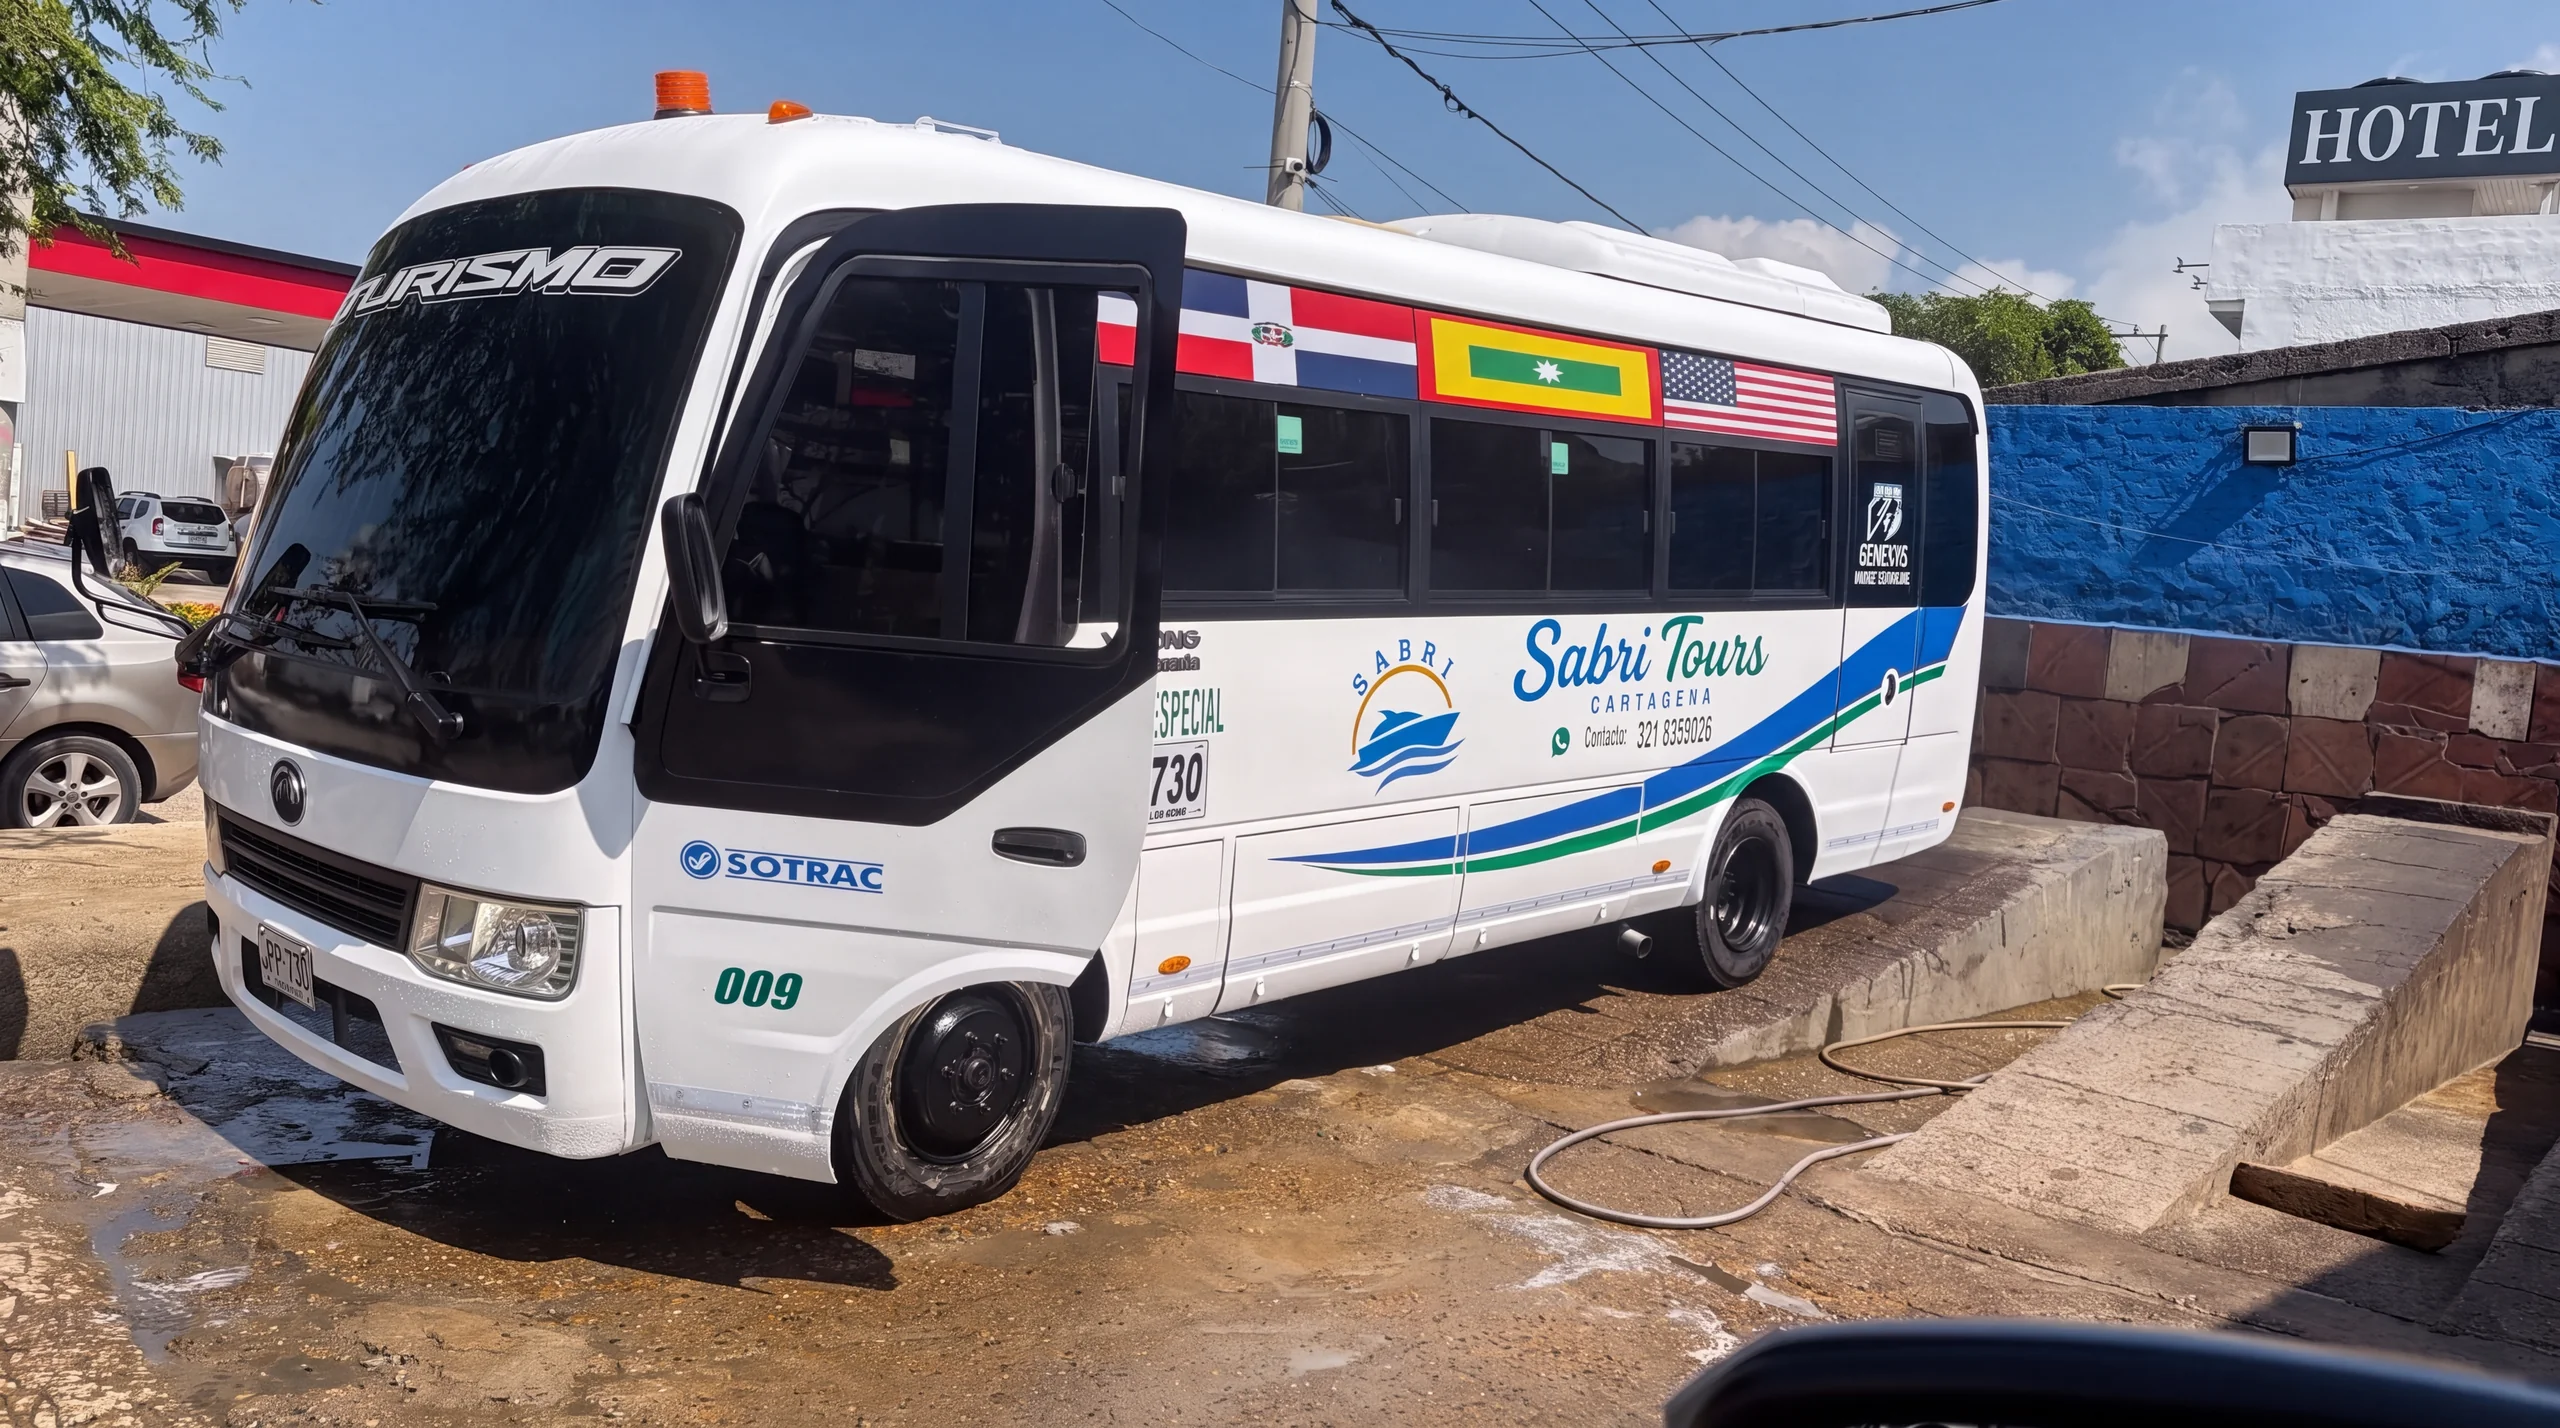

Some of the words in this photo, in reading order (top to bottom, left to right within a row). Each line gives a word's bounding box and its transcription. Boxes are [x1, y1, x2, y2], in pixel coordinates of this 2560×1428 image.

[2299, 96, 2556, 164] HOTEL
[1352, 639, 1454, 696] SABRI
[1513, 618, 1652, 702] Sabri
[1661, 615, 1770, 682] Tours
[1590, 688, 1711, 714] CARTAGENA
[1584, 725, 1628, 748] Contacto:
[1637, 720, 1659, 748] 321
[1662, 716, 1713, 746] 8359026
[1150, 752, 1203, 807] 730
[726, 852, 884, 890] SOTRAC
[714, 967, 803, 1010] 009
